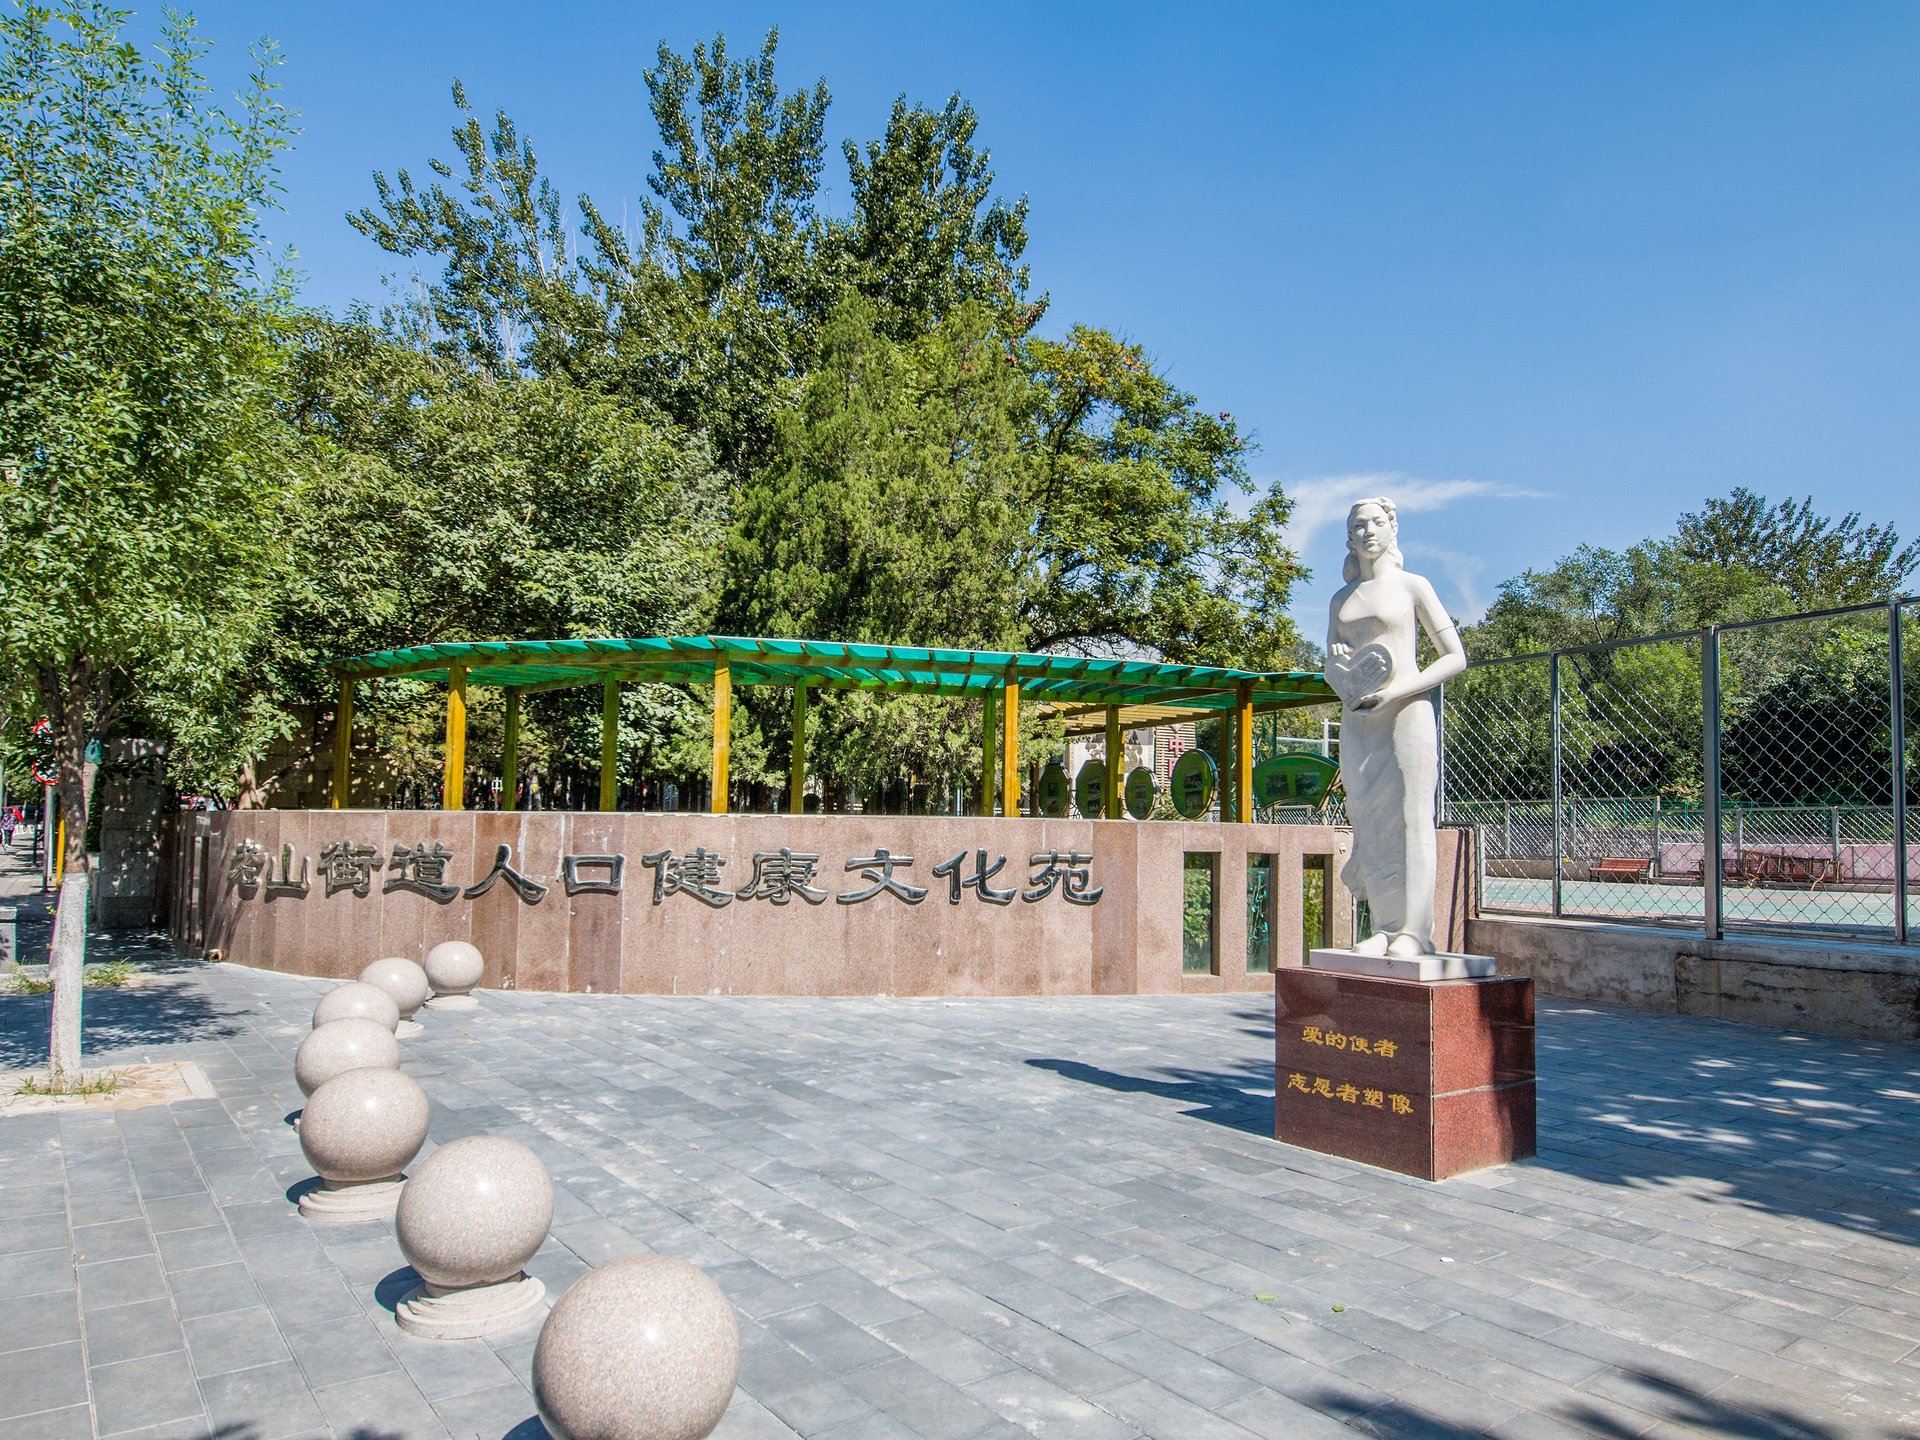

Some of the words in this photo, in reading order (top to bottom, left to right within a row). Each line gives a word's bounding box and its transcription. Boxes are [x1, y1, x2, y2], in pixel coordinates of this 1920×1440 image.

[228, 838, 1103, 905] 老山街道人口健康文化苑
[1301, 1025, 1398, 1058] 爱的使者
[1287, 1073, 1415, 1115] 志愿者塑像
